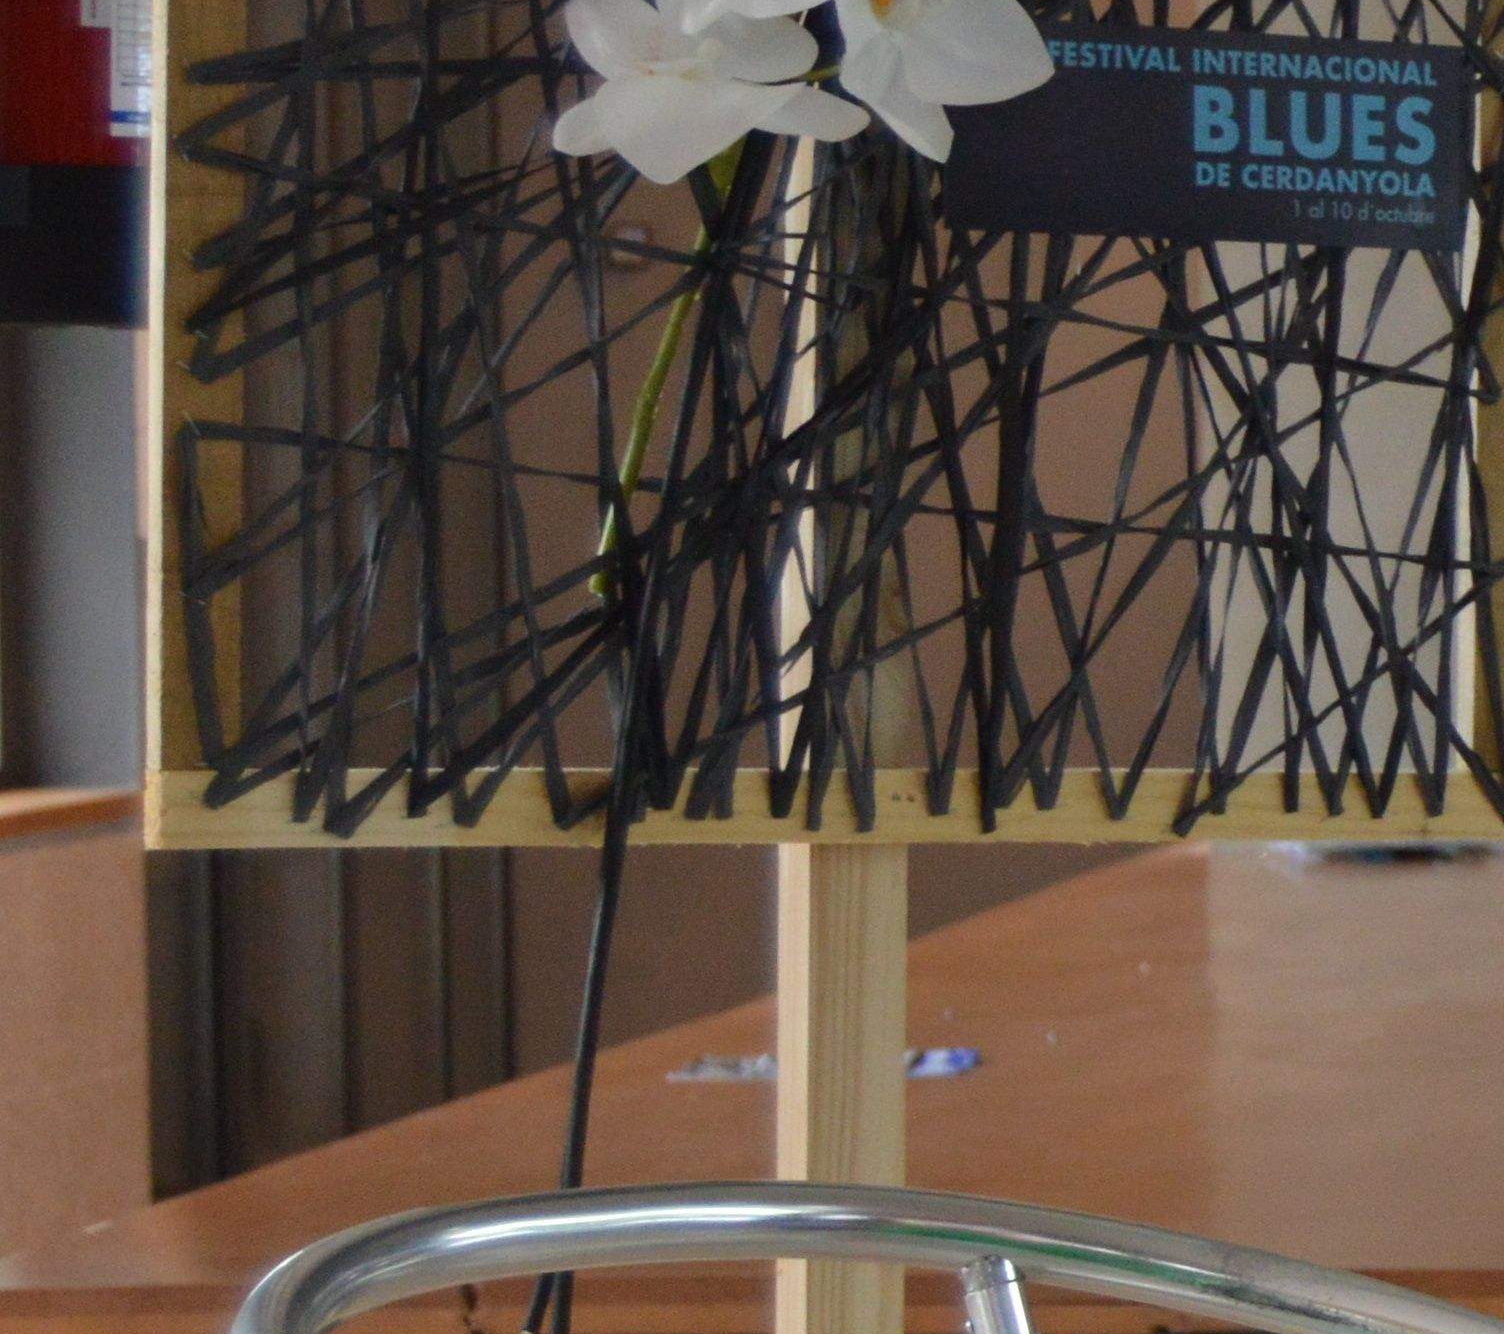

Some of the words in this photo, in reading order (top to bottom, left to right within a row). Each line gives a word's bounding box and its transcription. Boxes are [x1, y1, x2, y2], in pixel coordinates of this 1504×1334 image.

[1047, 39, 1181, 73] FESTIVAL
[1193, 47, 1437, 87] INTERNACIONAL
[1192, 84, 1437, 166] BLUES
[1194, 161, 1232, 189] DE
[1240, 165, 1436, 199] CERDANYOLA
[1309, 198, 1326, 220] al
[1332, 200, 1355, 222] 10
